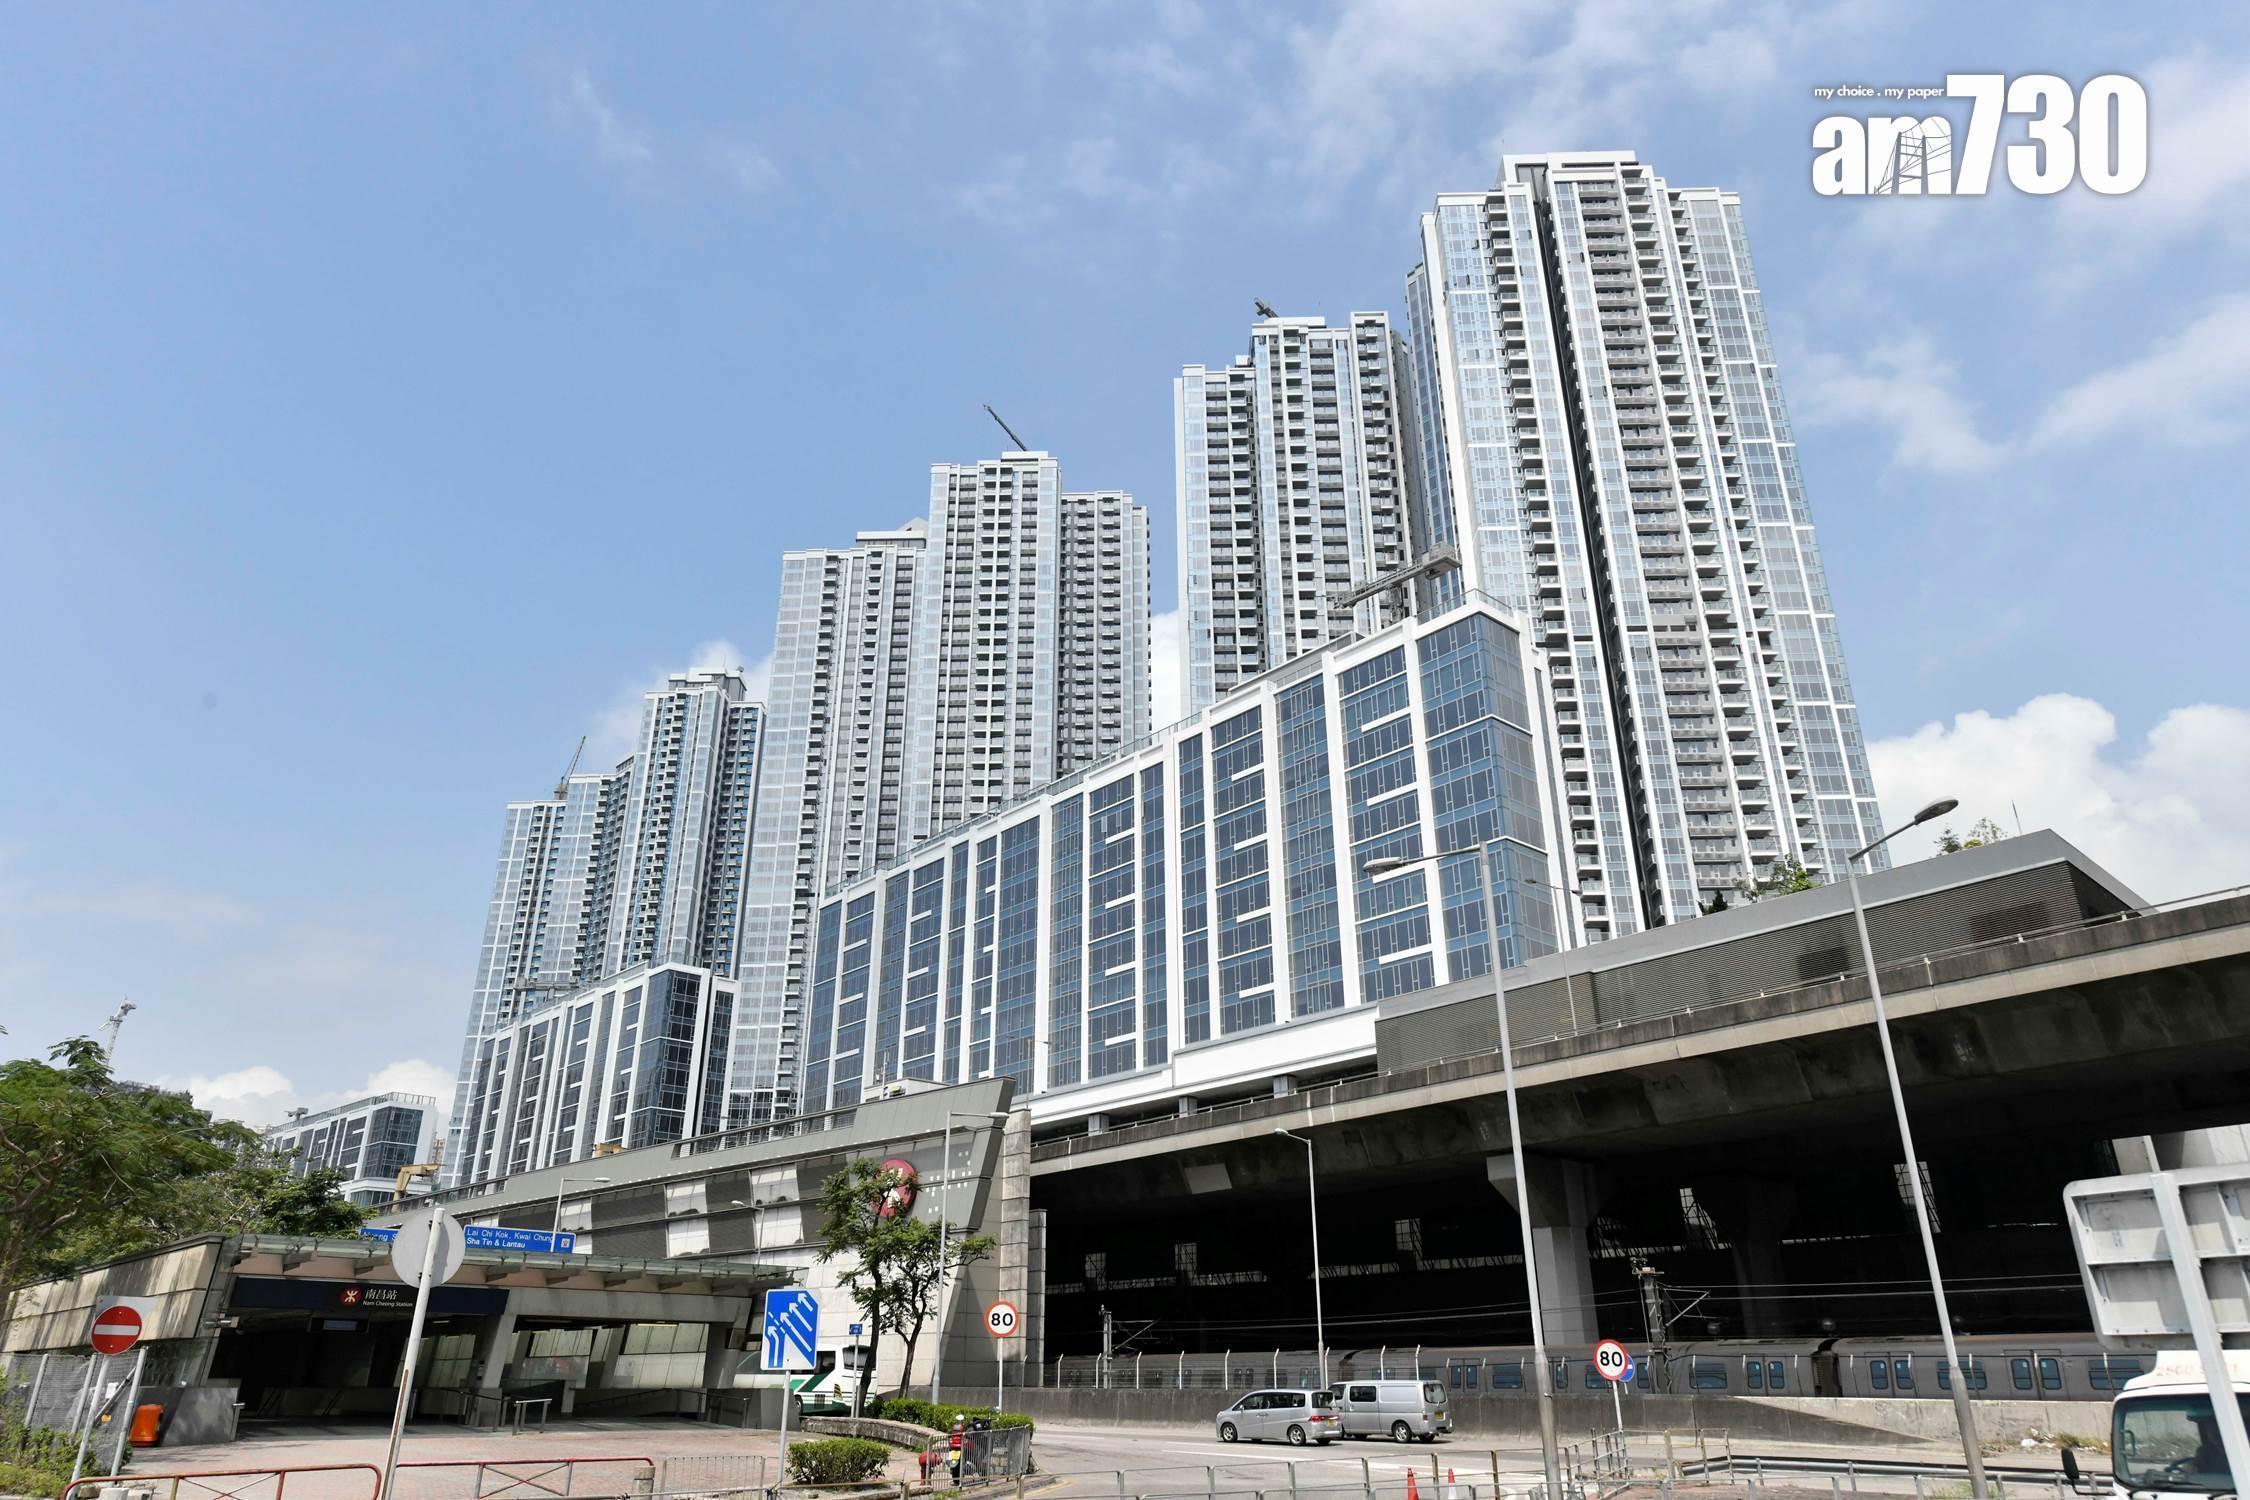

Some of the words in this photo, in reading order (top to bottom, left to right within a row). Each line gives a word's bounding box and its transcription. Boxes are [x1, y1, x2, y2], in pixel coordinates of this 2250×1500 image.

[481, 1229, 493, 1237] Chi
[514, 1232, 531, 1240] Kwai
[466, 1237, 480, 1245] Sha
[482, 1238, 493, 1246] Tin
[502, 1239, 526, 1248] Lantau
[991, 1313, 1013, 1326] 80
[1600, 1351, 1622, 1367] 80
